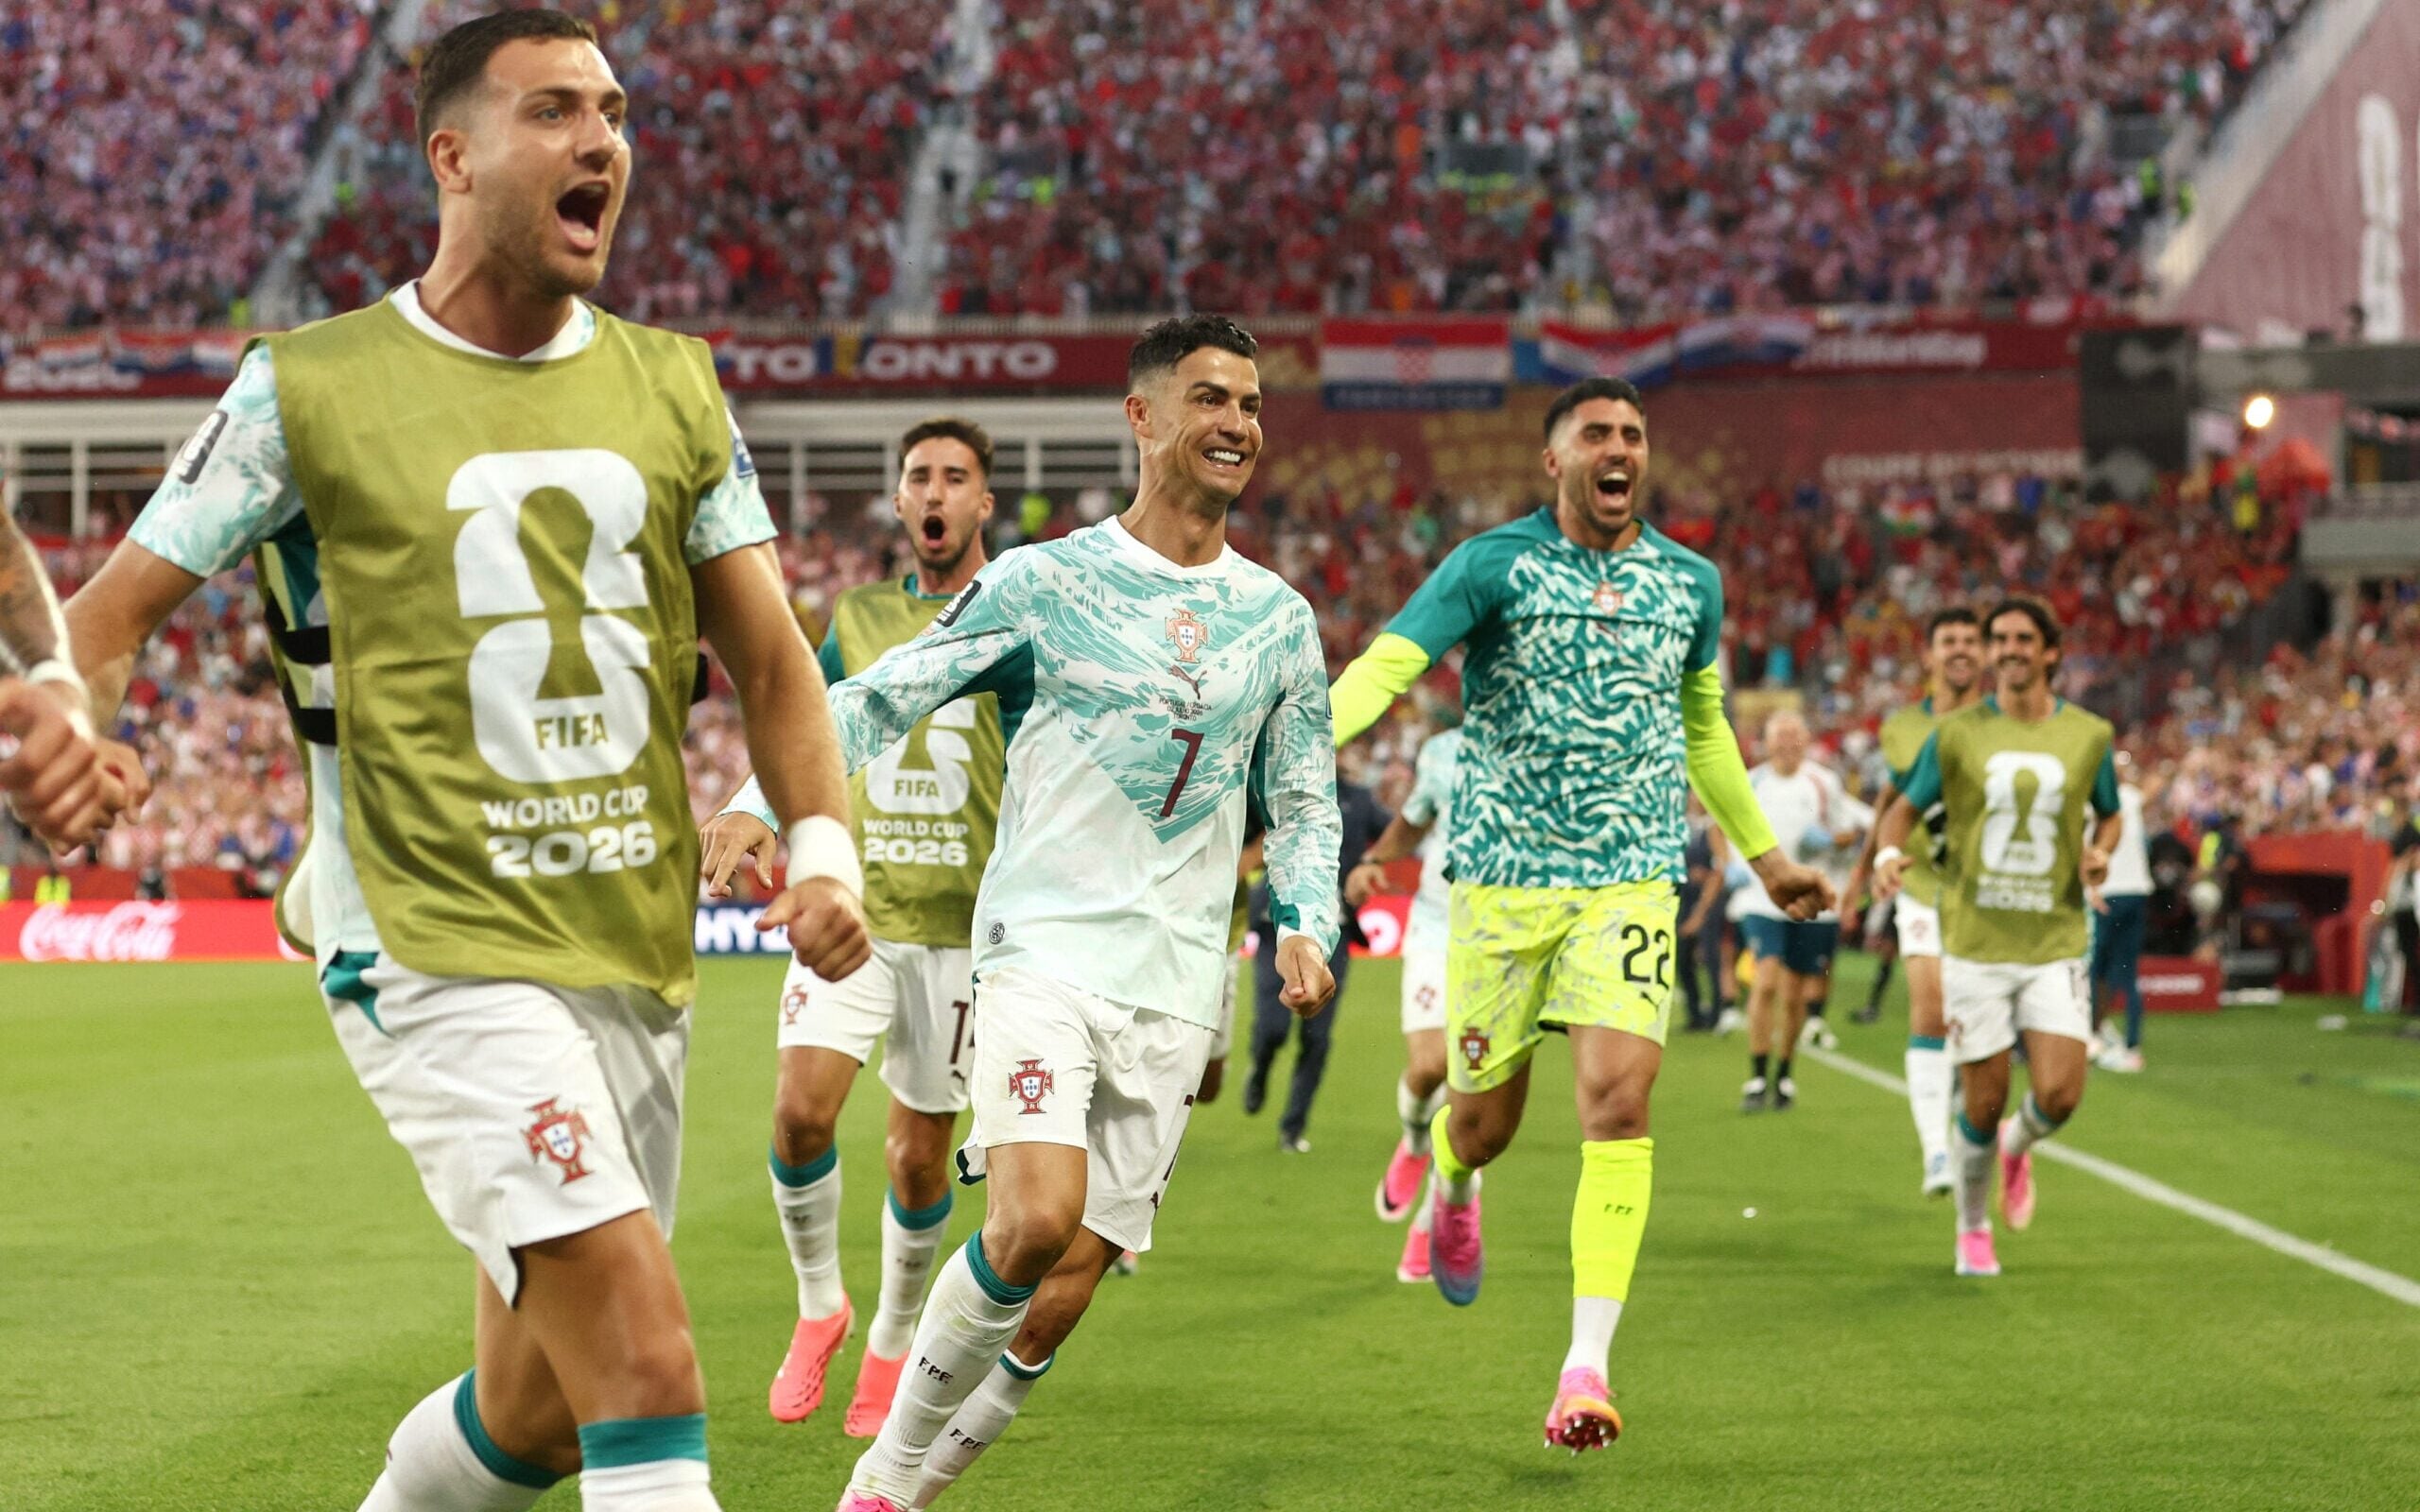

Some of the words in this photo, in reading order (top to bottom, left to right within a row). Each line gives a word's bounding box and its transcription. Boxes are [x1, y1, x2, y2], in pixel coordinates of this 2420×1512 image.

[732, 341, 1058, 383] TOONTO
[535, 713, 608, 750] FIFA
[894, 779, 940, 797] FIFA
[1160, 729, 1204, 817] 7
[480, 793, 600, 830] WORLD
[604, 784, 649, 817] CUP
[862, 819, 929, 837] WORLD
[932, 822, 968, 839] CUP
[485, 820, 658, 879] 2026
[864, 837, 969, 868] 2026
